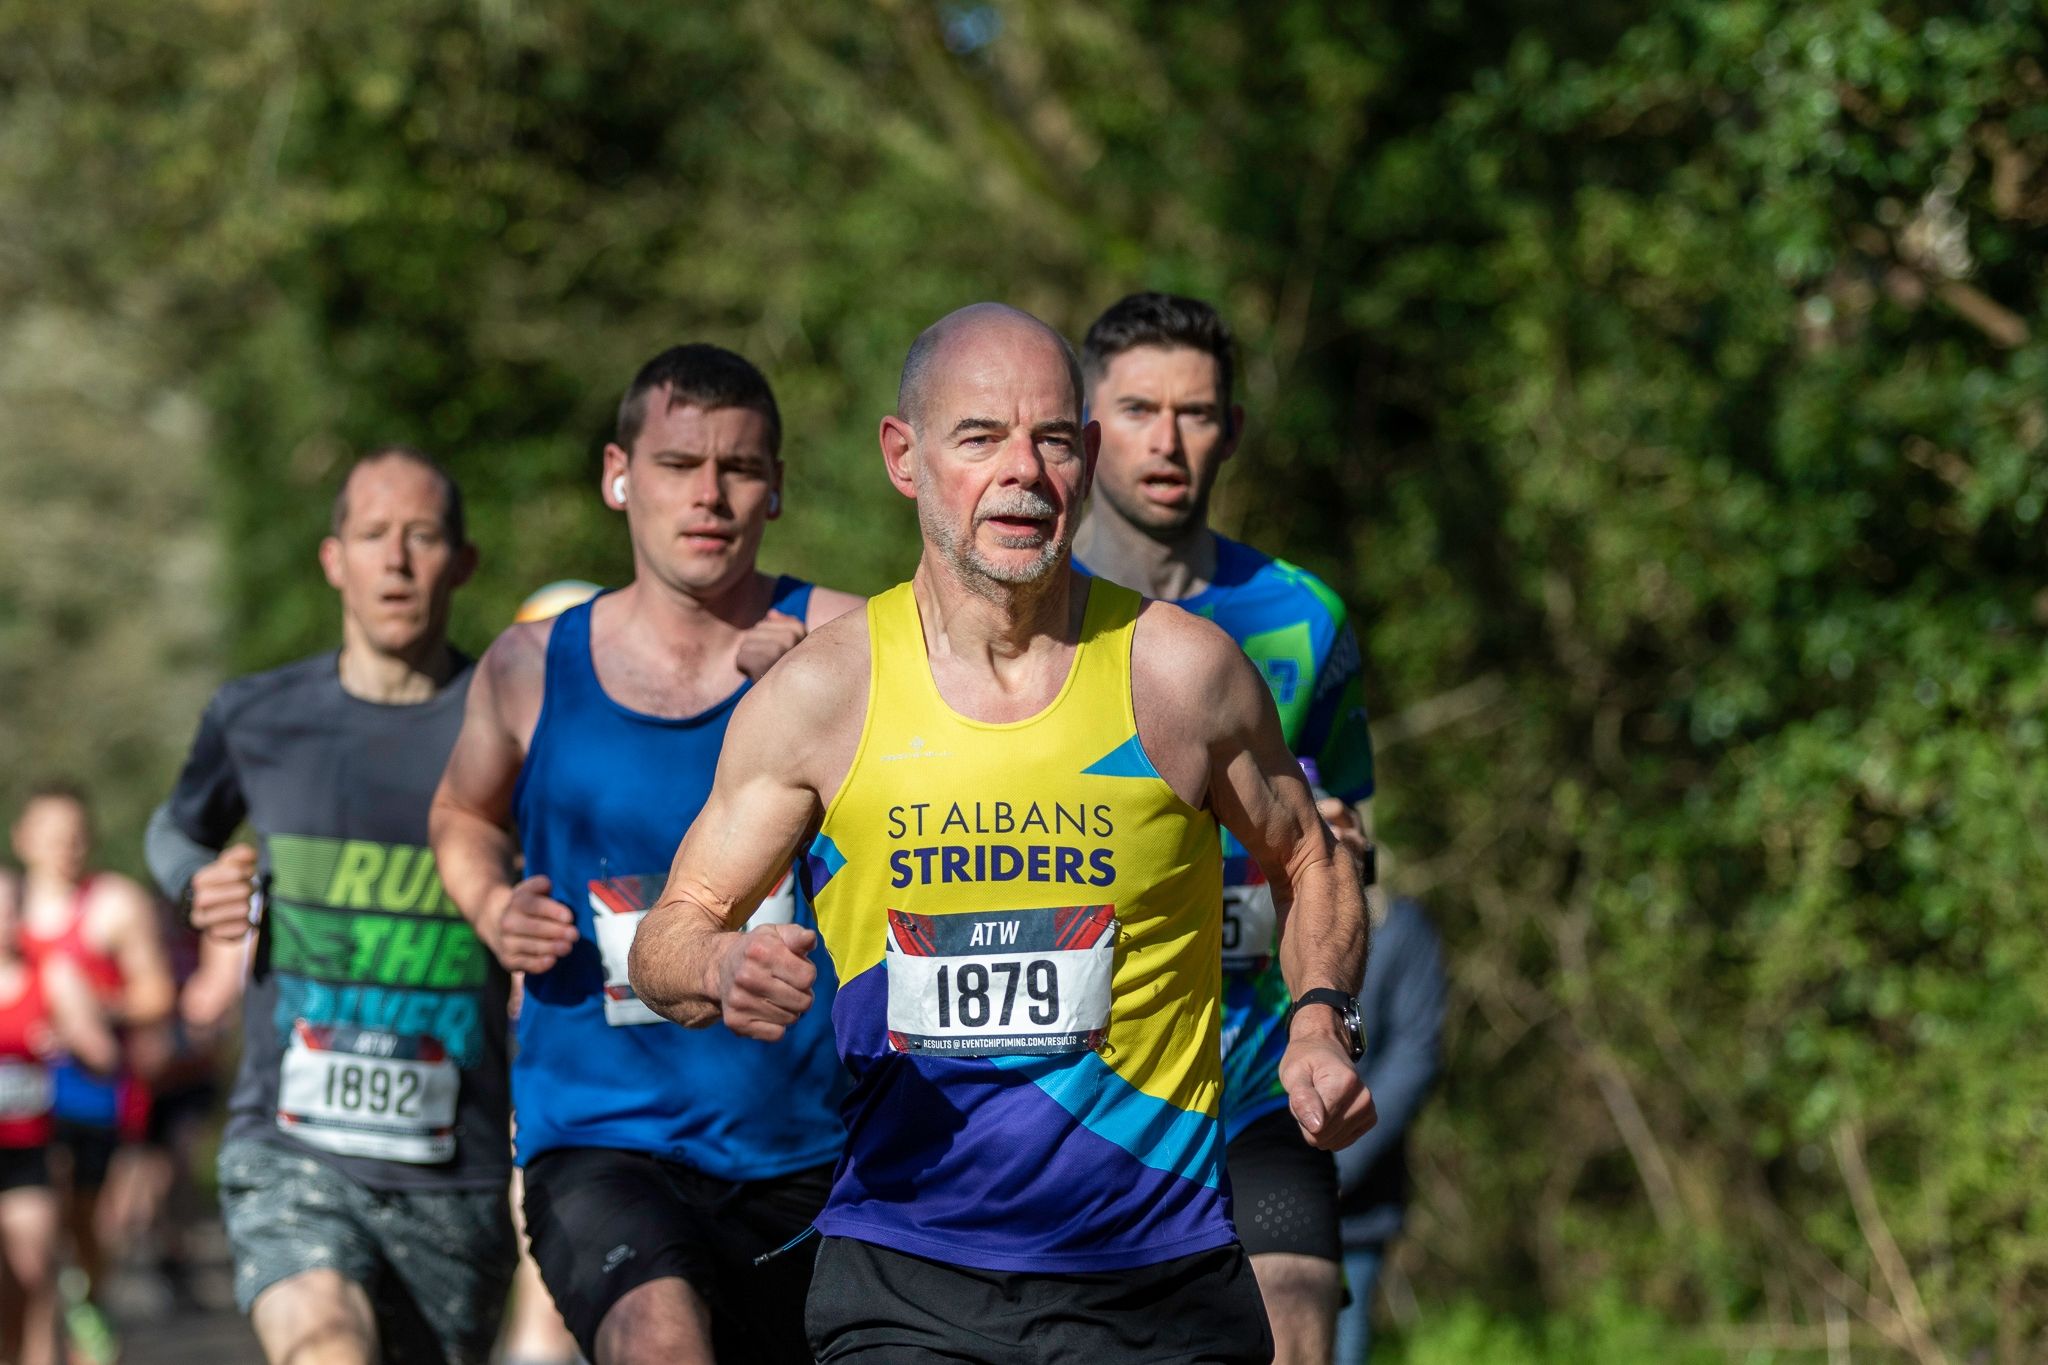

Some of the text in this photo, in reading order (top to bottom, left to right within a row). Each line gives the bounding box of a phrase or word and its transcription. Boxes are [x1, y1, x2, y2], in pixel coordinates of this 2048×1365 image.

[888, 801, 1114, 839] ST ALBANS
[890, 845, 1117, 888] STRIDERS
[350, 915, 476, 988] THE
[969, 921, 1020, 946] ATW
[937, 960, 1060, 1028] 1879
[923, 1036, 1077, 1049] RESULTS @ EVENTCHIPTIMING.COM/RESULTS
[325, 1064, 419, 1118] 1892
